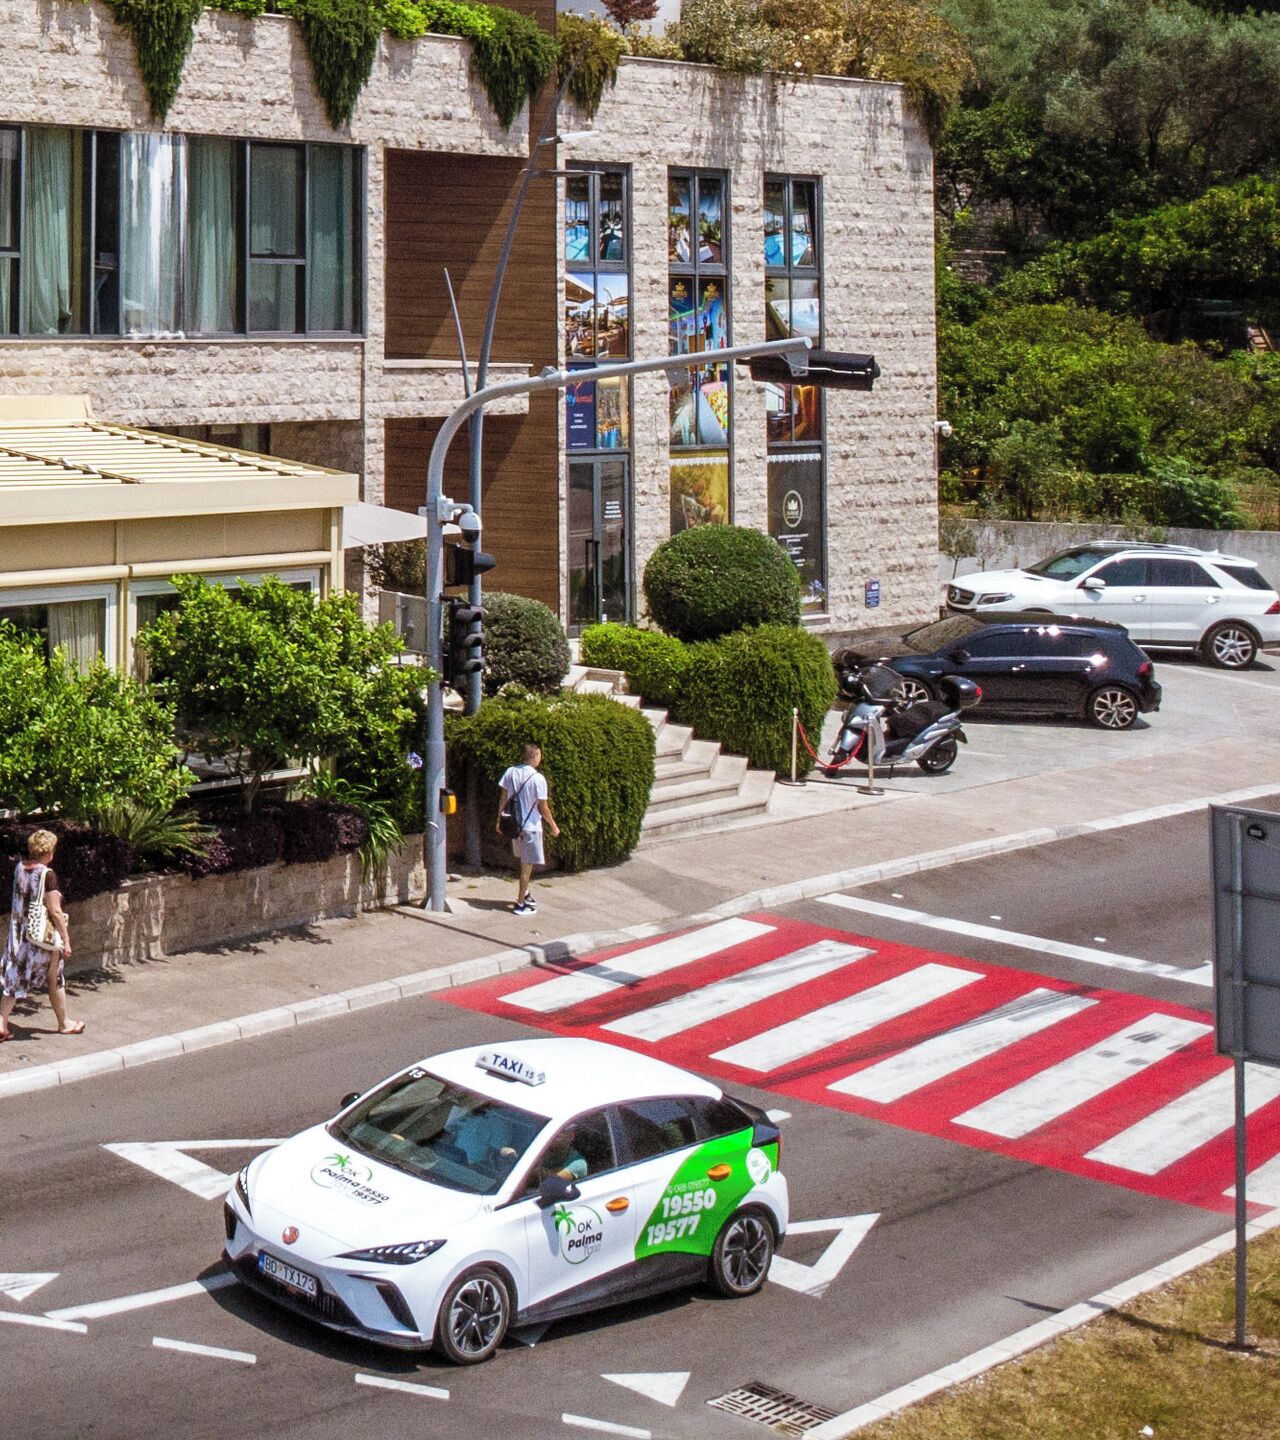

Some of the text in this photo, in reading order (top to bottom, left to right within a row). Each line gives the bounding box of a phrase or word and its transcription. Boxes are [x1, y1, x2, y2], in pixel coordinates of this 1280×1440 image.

[493, 1053, 523, 1074] TAXI
[525, 1070, 535, 1079] 15
[662, 1187, 717, 1218] 19550
[577, 1219, 592, 1234] OK
[646, 1214, 700, 1246] 19577
